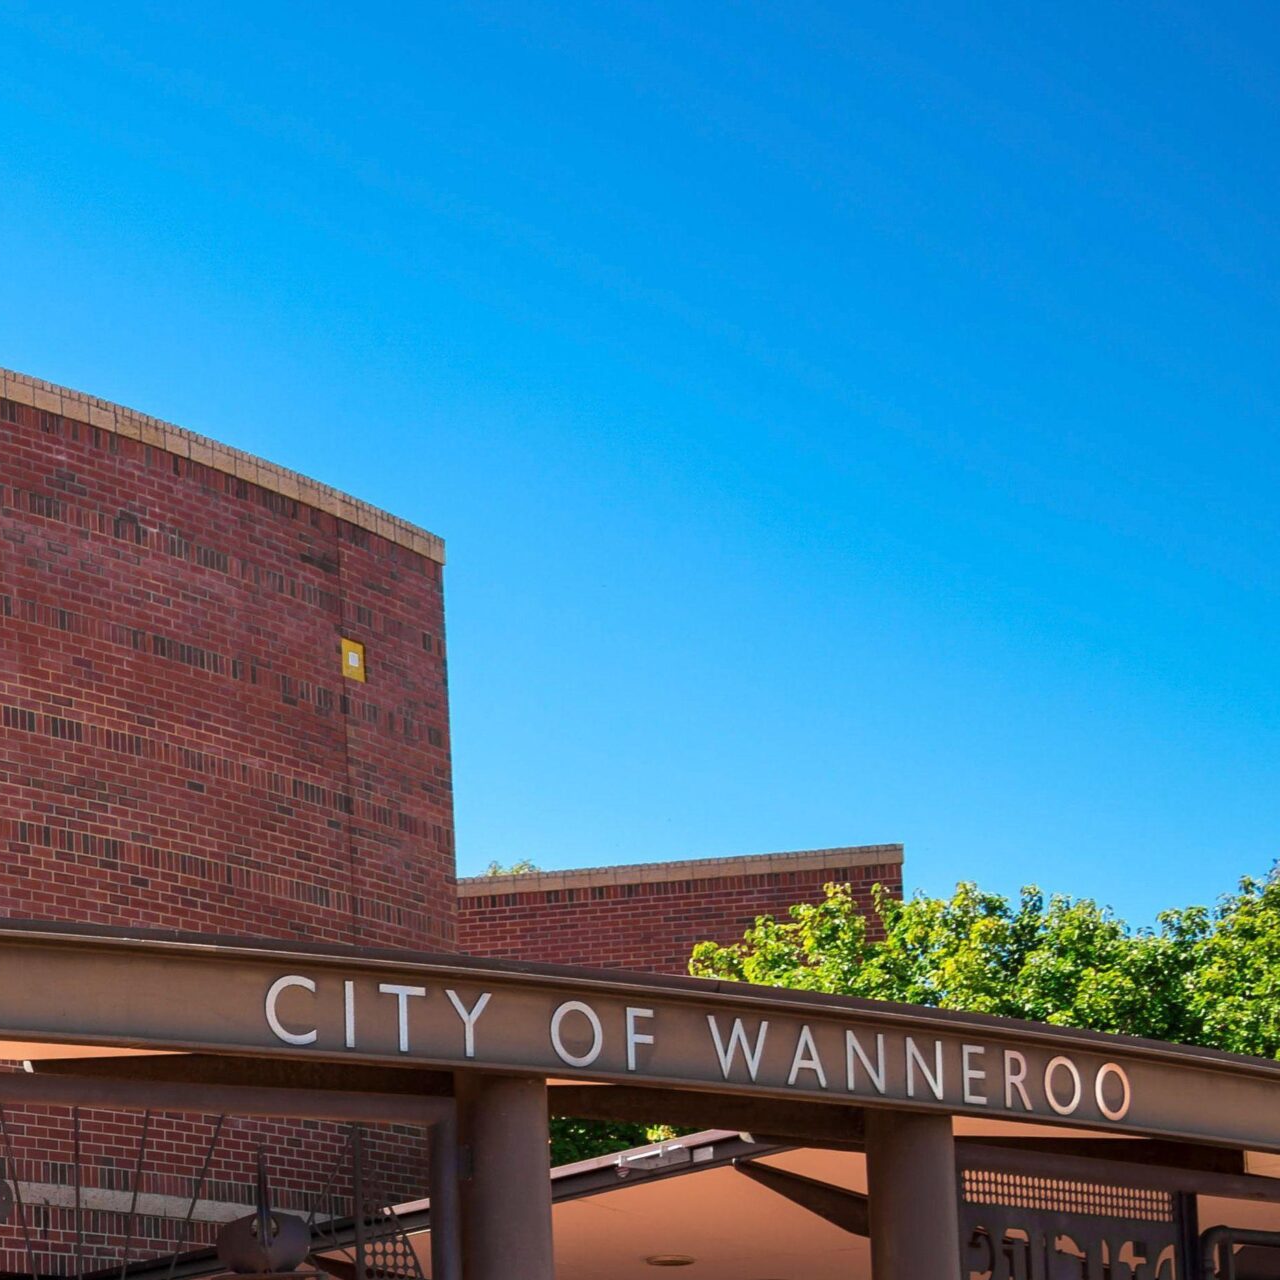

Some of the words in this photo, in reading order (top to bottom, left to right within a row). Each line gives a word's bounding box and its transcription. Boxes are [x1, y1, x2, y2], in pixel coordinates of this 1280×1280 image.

[265, 975, 491, 1057] CITY
[550, 1000, 654, 1071] OF
[707, 1015, 1131, 1121] WANNEROO
